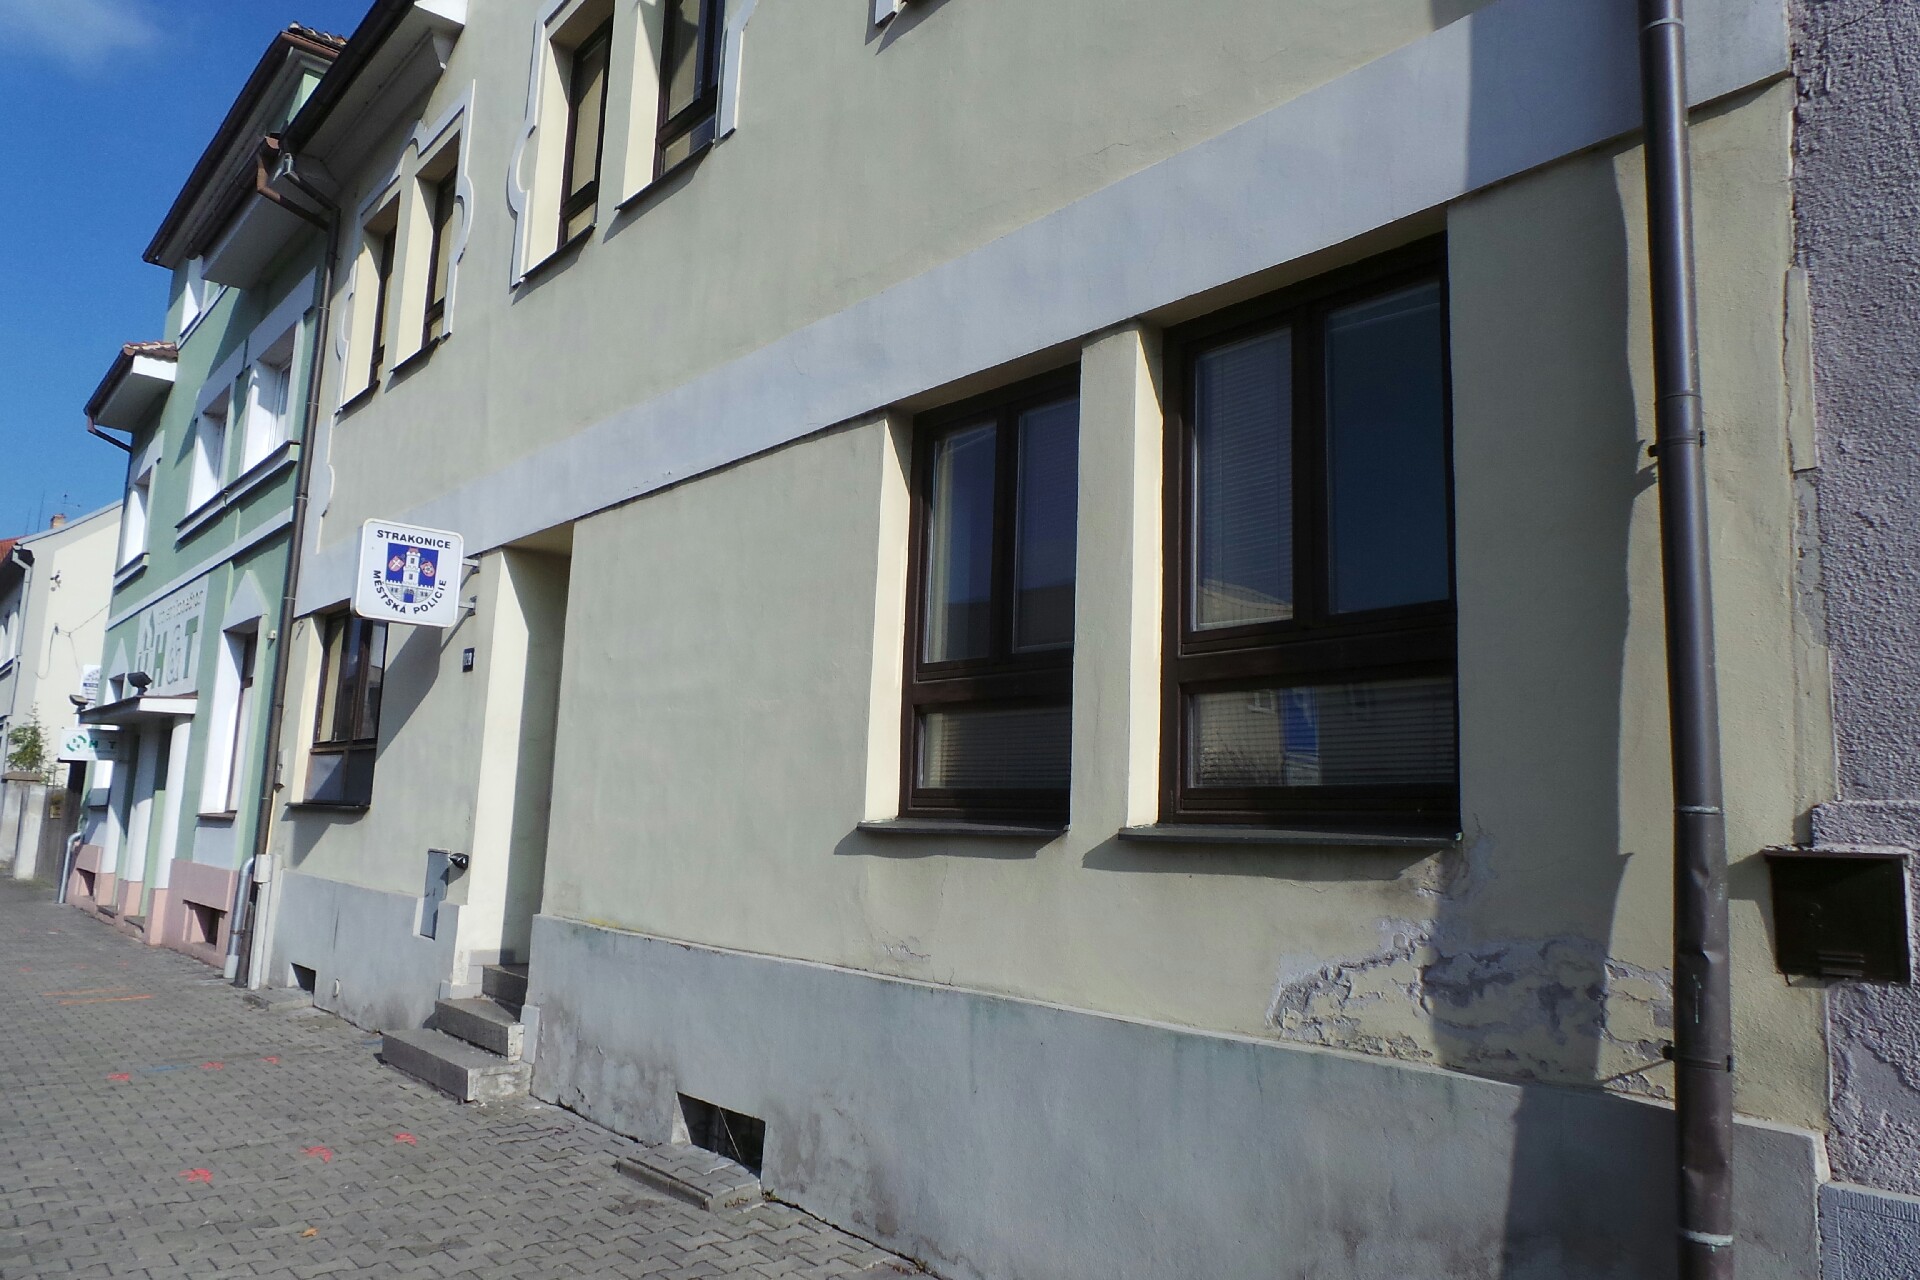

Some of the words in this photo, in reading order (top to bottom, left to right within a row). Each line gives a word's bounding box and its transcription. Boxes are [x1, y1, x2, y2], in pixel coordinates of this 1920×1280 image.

[377, 529, 451, 549] STRAKONICE
[373, 570, 406, 614] MĚSTSKÁ
[413, 579, 447, 614] POLICIE
